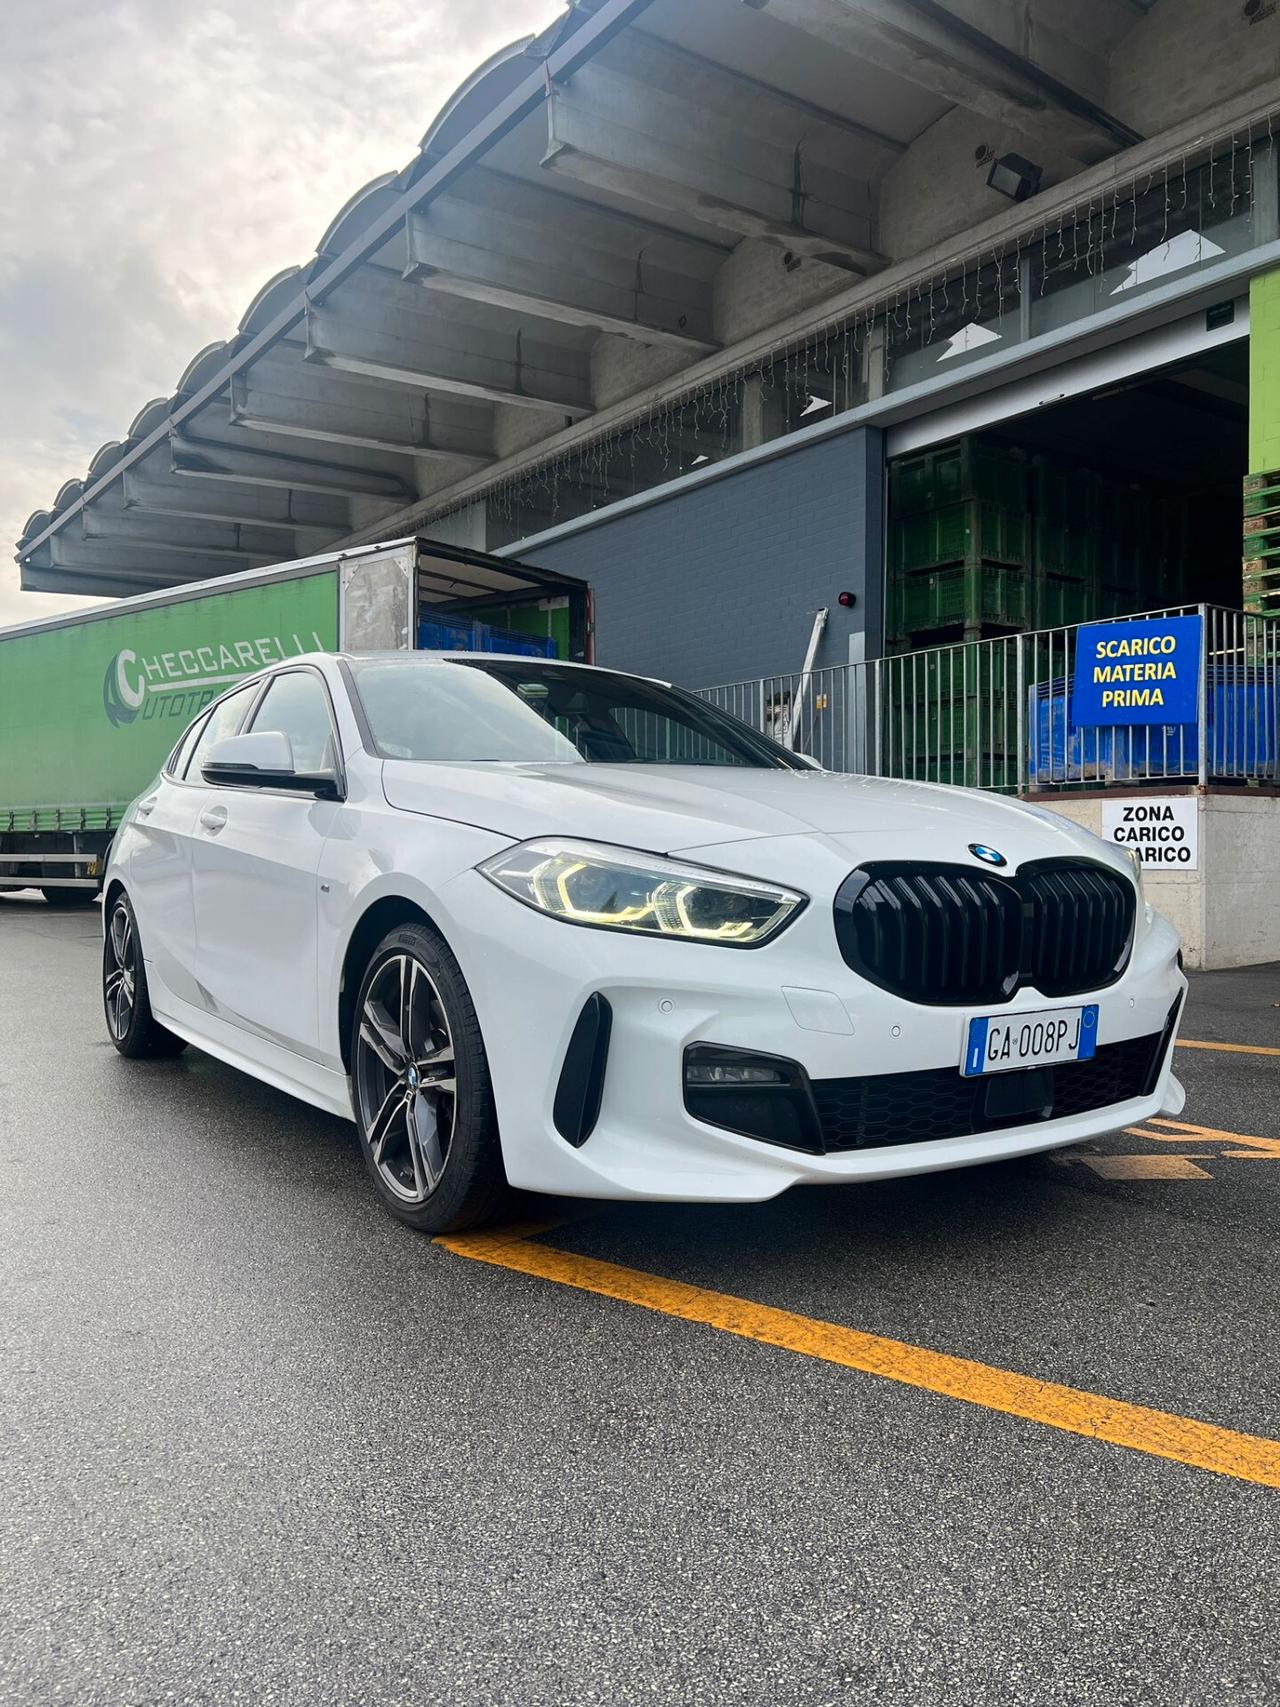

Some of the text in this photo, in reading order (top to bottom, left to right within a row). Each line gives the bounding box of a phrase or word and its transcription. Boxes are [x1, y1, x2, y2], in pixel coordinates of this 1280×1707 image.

[1095, 635, 1176, 659] SCARICO
[1093, 661, 1177, 683] MATERIA
[1102, 688, 1164, 708] PRIMA
[1123, 806, 1174, 822] ZONA
[1113, 826, 1185, 842] CARICO
[1135, 846, 1191, 862] ARICO
